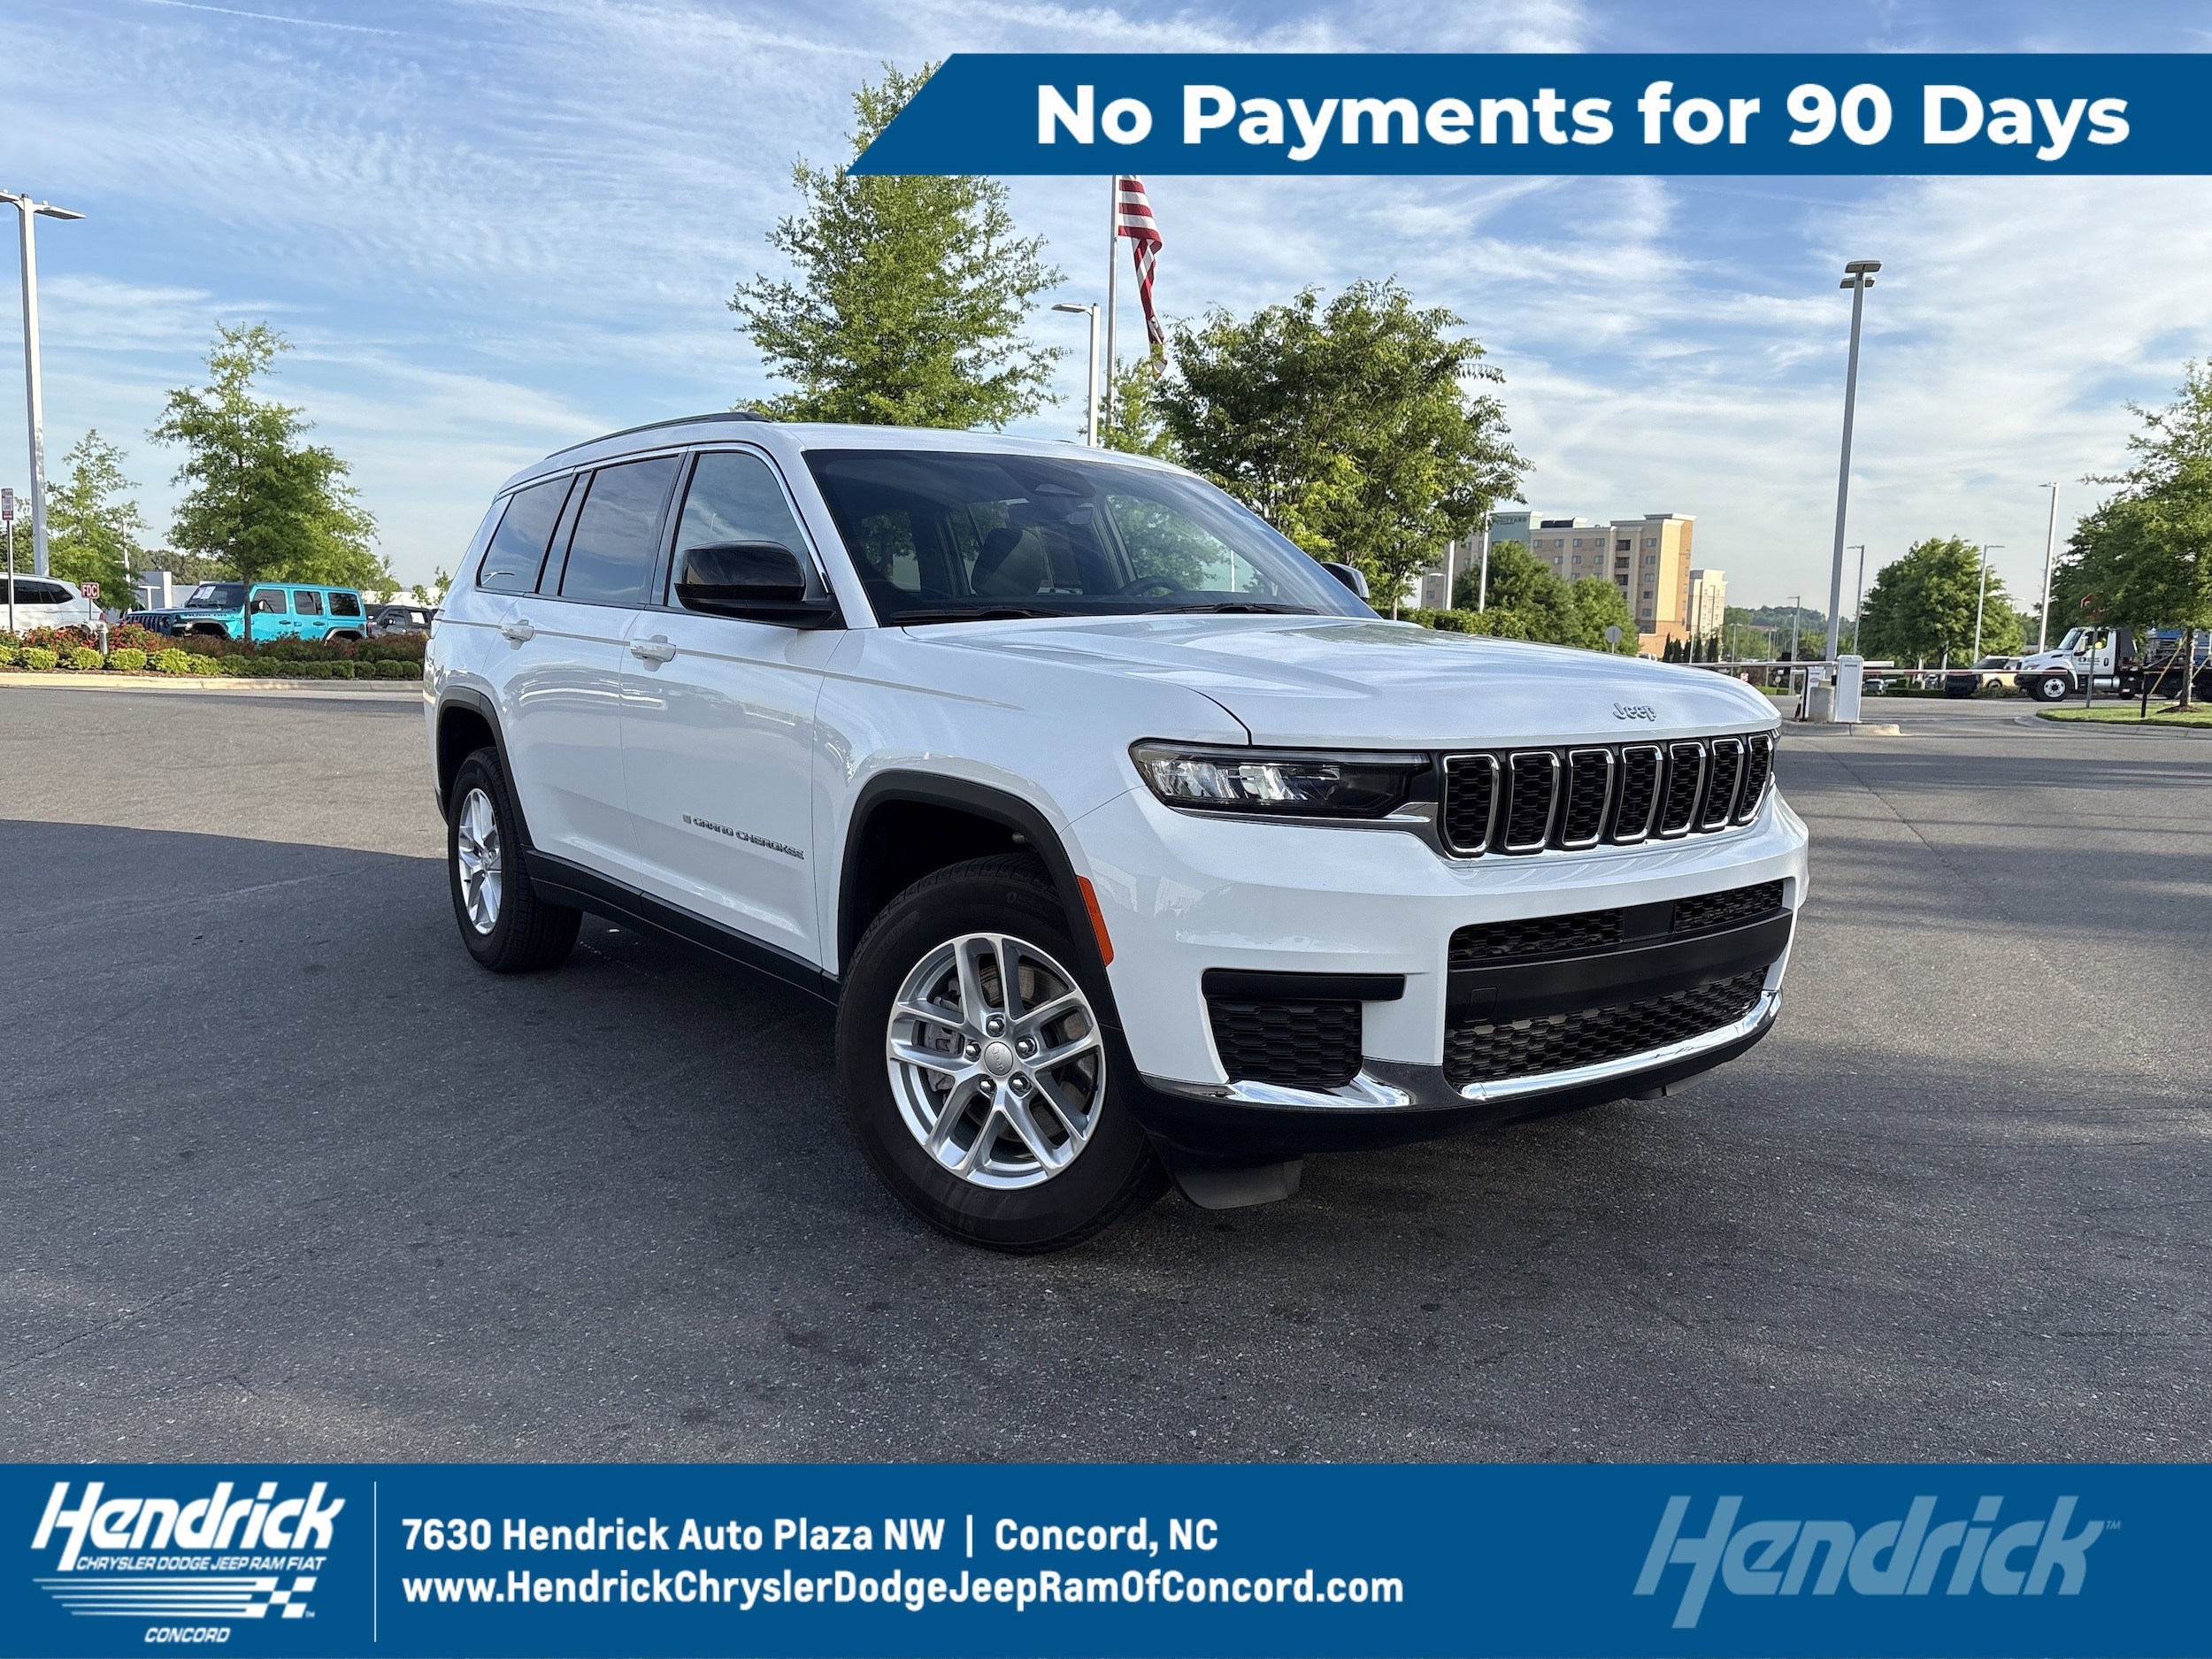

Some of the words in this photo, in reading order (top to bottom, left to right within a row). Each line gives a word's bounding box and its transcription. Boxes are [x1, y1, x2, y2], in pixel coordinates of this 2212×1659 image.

[82, 584, 97, 597] FDC
[1613, 703, 1657, 722] Jeep
[693, 818, 733, 837] GRAND
[735, 830, 804, 860] CHEROKEE
[992, 1046, 1005, 1071] Jeep
